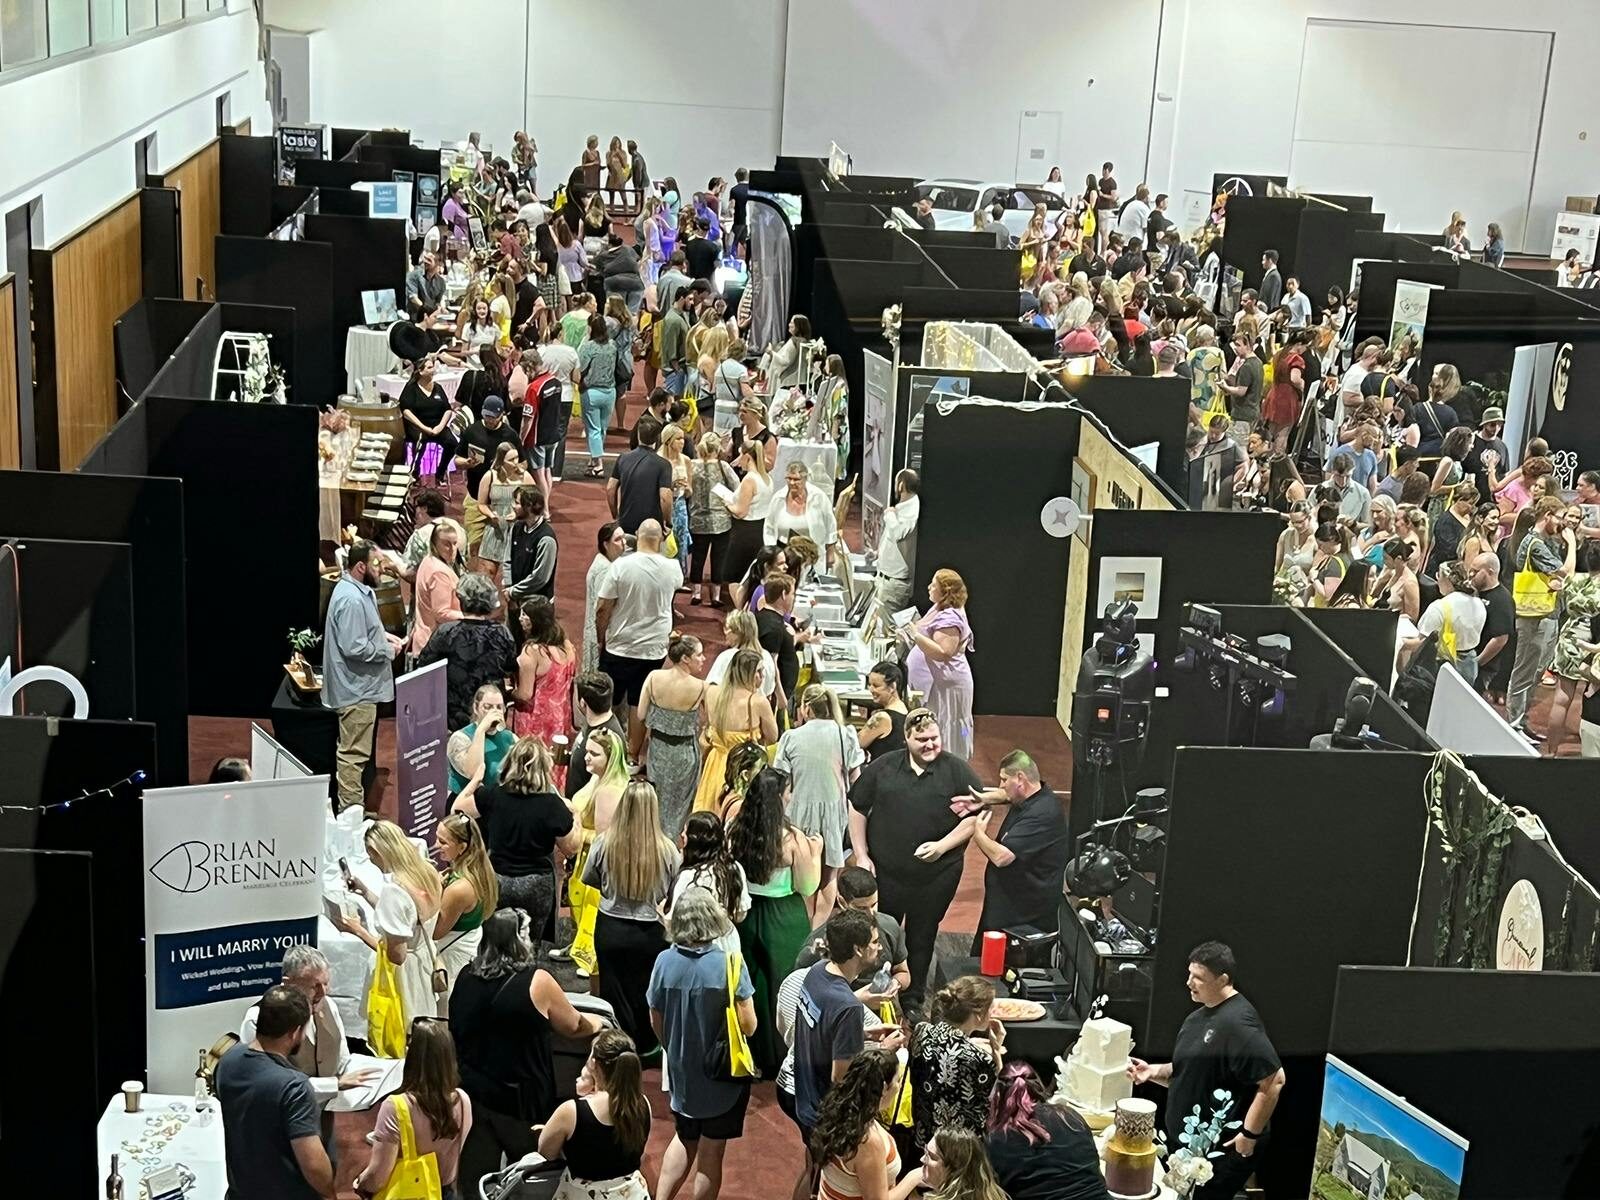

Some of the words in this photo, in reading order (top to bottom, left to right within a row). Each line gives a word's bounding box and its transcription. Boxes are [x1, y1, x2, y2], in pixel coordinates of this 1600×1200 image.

[282, 133, 318, 148] taste
[170, 950, 176, 963] I
[179, 945, 214, 962] WILL
[217, 938, 270, 957] MARRY
[273, 933, 310, 950] YOU!
[181, 970, 209, 981] Wicked
[247, 963, 264, 971] Vow
[207, 983, 222, 992] and
[222, 981, 241, 990] Baby
